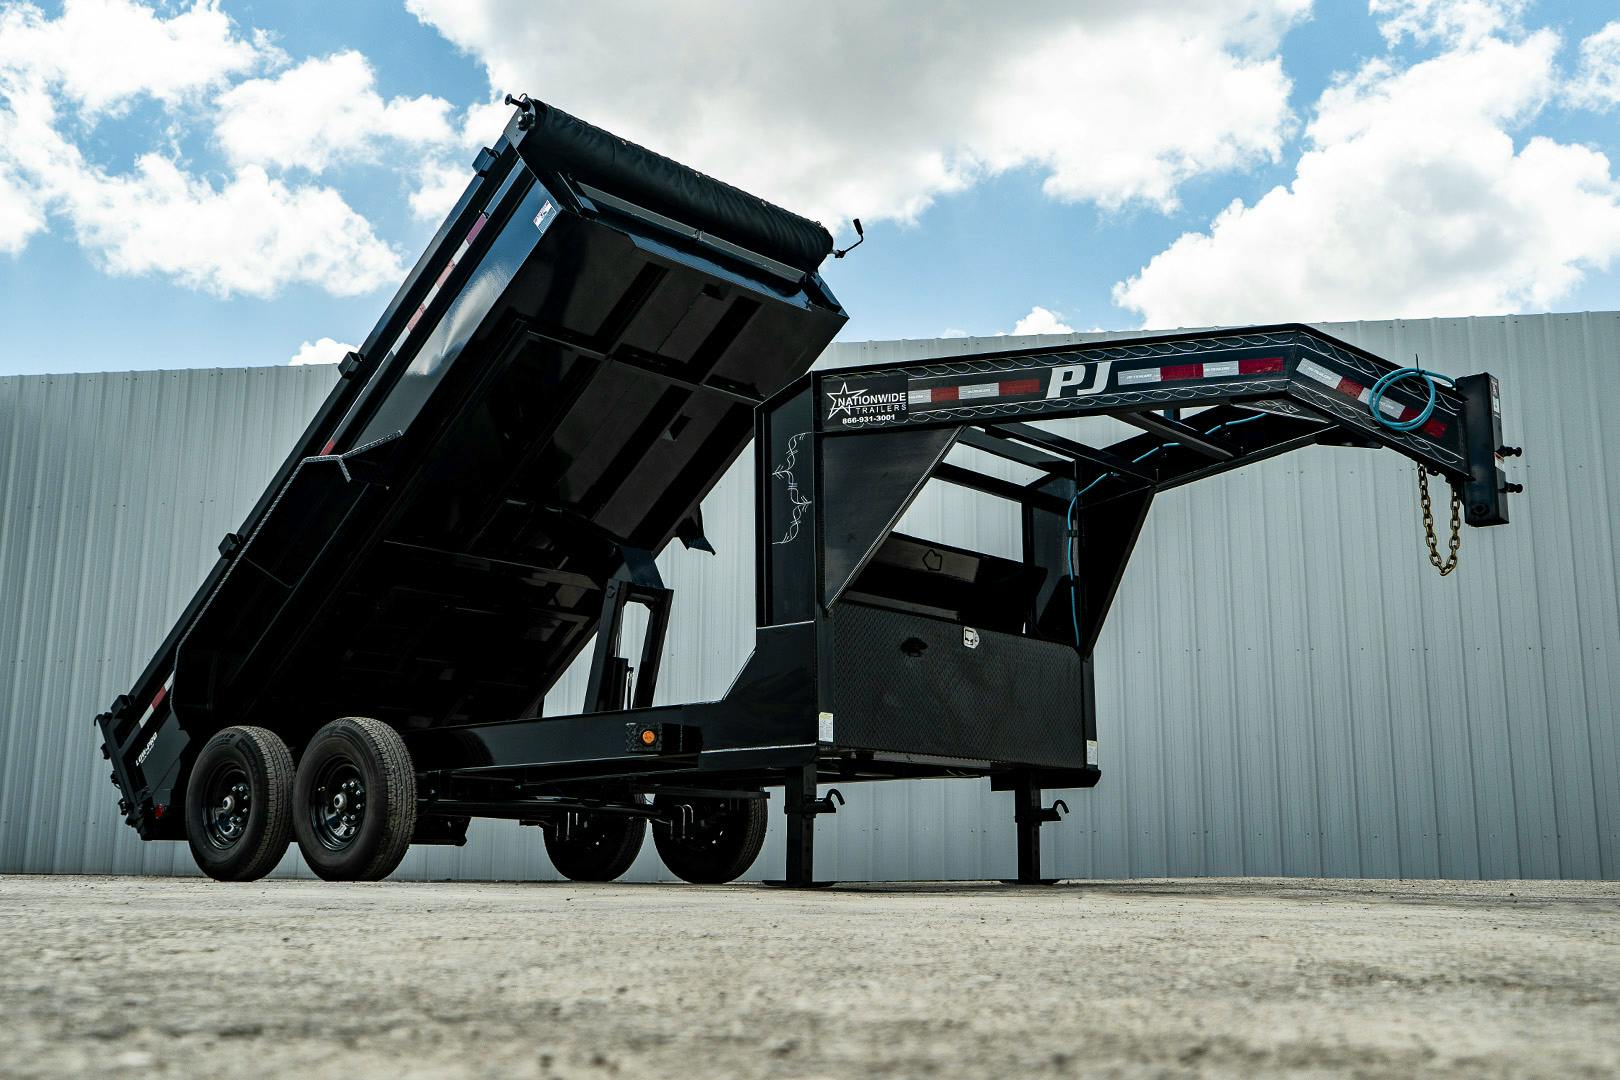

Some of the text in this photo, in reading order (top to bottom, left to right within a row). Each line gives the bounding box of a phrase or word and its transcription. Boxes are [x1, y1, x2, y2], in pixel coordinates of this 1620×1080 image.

[1046, 361, 1113, 398] PJ
[837, 392, 907, 406] NATIONWIDE
[855, 404, 907, 414] TRAILERS
[842, 414, 895, 424] 866-931-3001
